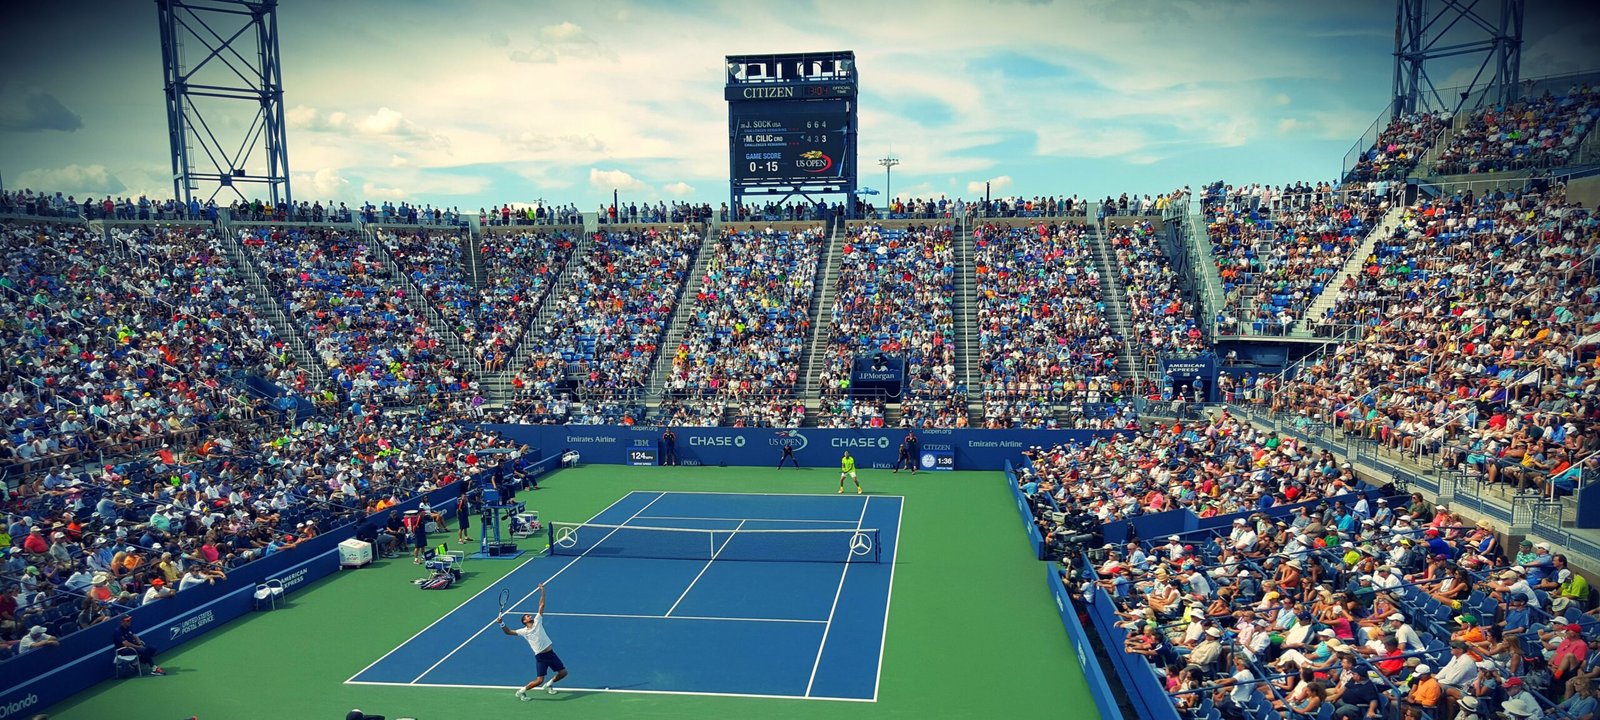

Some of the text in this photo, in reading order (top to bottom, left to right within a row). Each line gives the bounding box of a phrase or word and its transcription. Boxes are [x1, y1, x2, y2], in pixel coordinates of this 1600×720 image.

[743, 87, 794, 98] CITIZEN
[745, 121, 752, 129] J.
[753, 120, 771, 128] SOCK
[806, 121, 812, 129] 6
[814, 120, 820, 129] 6
[822, 120, 827, 128] 4
[746, 135, 755, 143] M.
[755, 134, 773, 142] CILIC
[806, 135, 812, 143] 4
[814, 135, 820, 143] 3
[821, 134, 827, 142] 3
[749, 161, 757, 172] 0
[766, 161, 778, 172] 15
[796, 160, 827, 168] US OPEN
[566, 435, 616, 443] Emirates Airline
[633, 439, 650, 447] IBM
[689, 436, 732, 446] CHASE
[768, 438, 802, 446] US OPEN
[831, 437, 875, 447] CHASE
[968, 440, 1023, 448] Emirates Airline
[631, 451, 646, 460] 124
[937, 457, 953, 465] 1:36
[281, 567, 308, 584] AMERICAN
[182, 609, 213, 627] UNITED STATES
[181, 622, 198, 634] POSTAL
[0, 692, 38, 719] Orlando
